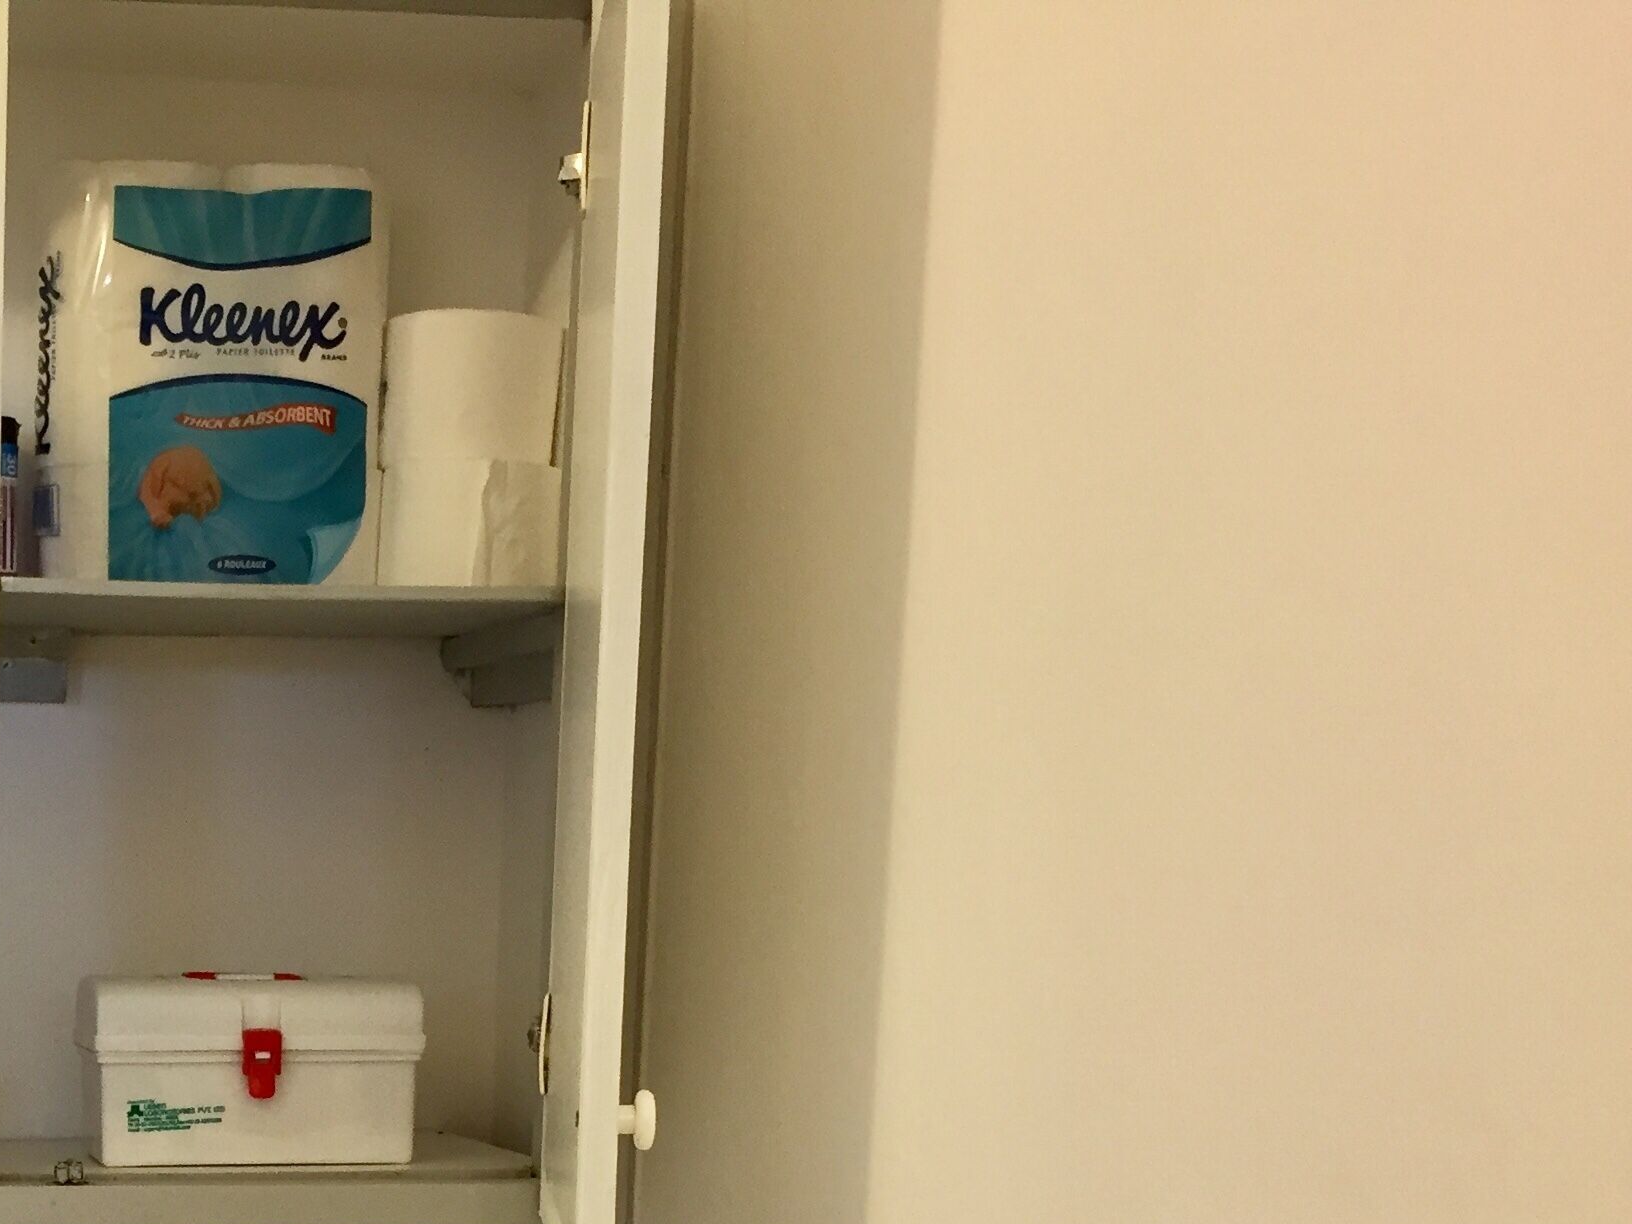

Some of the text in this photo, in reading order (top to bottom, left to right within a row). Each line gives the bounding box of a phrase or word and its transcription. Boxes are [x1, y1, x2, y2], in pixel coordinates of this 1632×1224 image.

[139, 283, 347, 363] Kleenex
[183, 405, 332, 429] THICK & ABSORBENT
